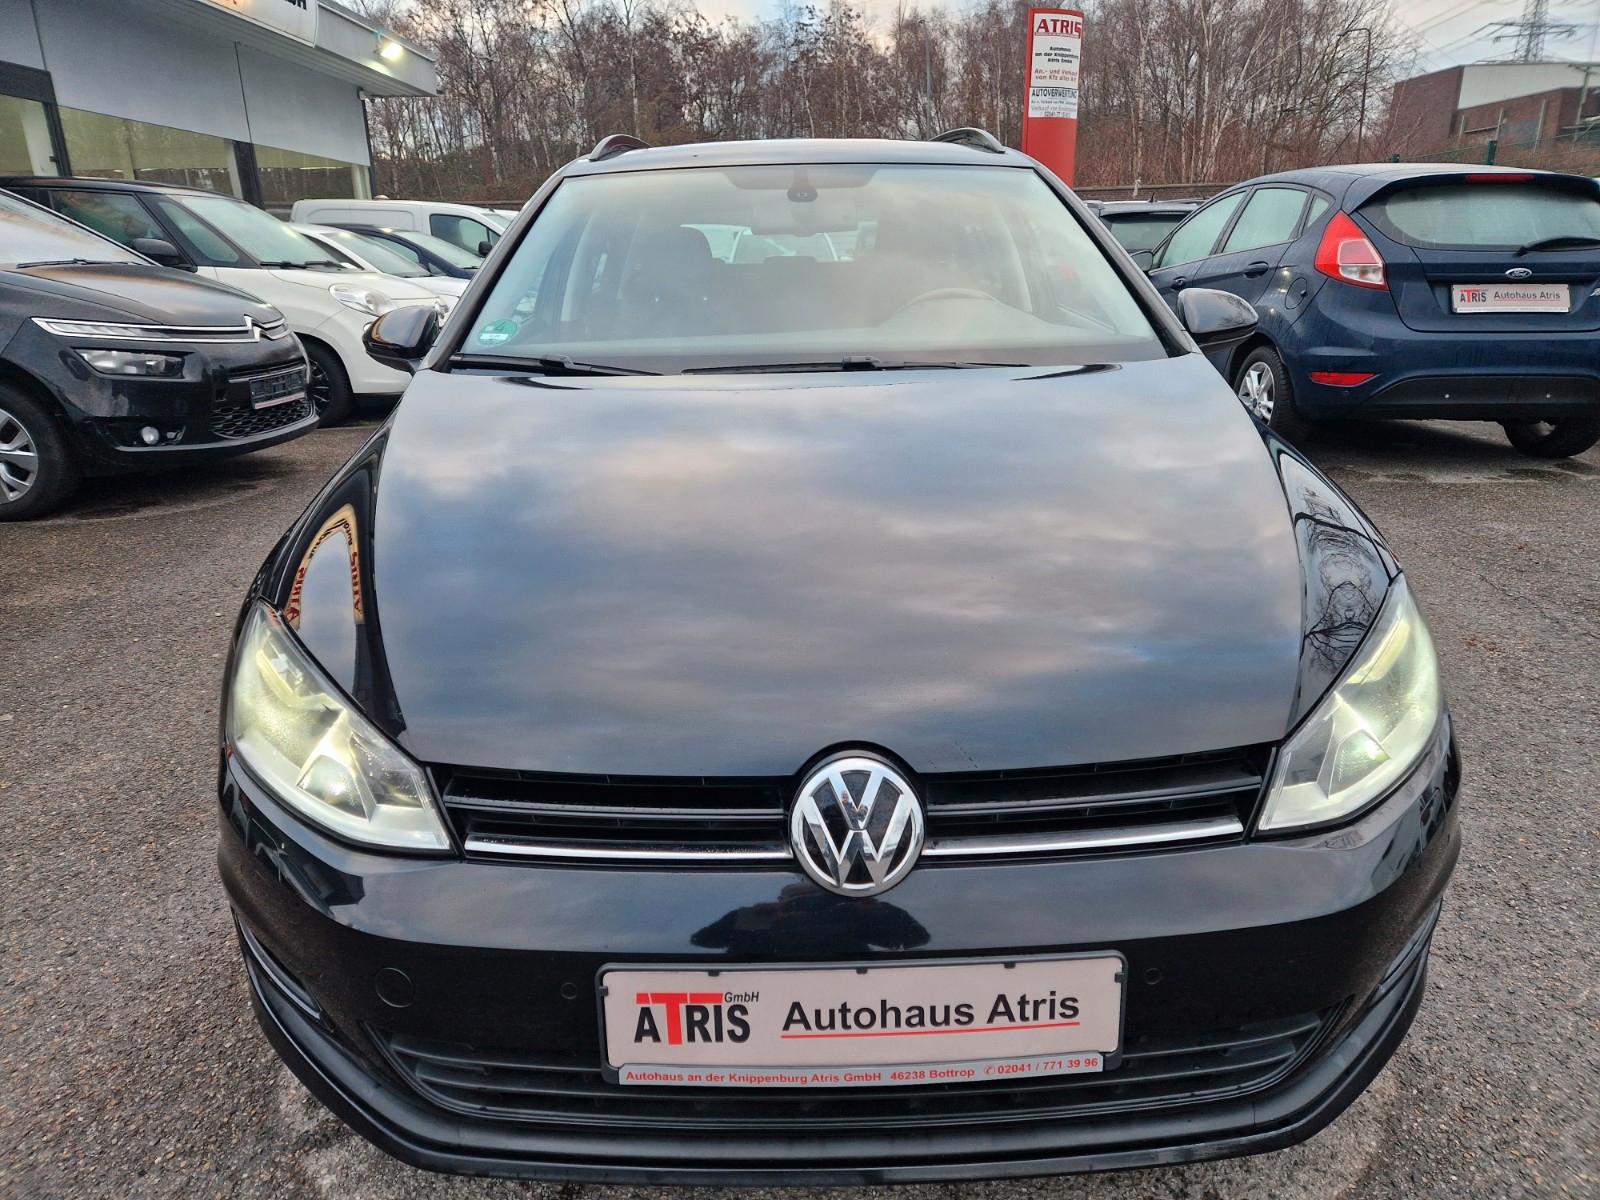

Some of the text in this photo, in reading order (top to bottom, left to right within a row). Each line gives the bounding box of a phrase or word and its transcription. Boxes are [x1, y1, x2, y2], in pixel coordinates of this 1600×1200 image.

[1036, 18, 1082, 35] ATRIS
[1510, 269, 1528, 278] Ford
[1460, 288, 1487, 303] ATRIS
[1494, 291, 1561, 300] Autohaus Atris
[797, 762, 918, 890] VW
[724, 991, 760, 1004] GmbH
[634, 993, 751, 1046] ATRIS
[782, 989, 1081, 1033] Autohaus Atris
[625, 1071, 684, 1082] Autohaus
[687, 1074, 702, 1082] an
[705, 1072, 725, 1083] der
[729, 1073, 808, 1085] Knippenburg
[811, 1073, 840, 1083] Atris
[843, 1072, 882, 1083] GmbH
[890, 1070, 926, 1081] 46238
[929, 1068, 976, 1079] Bottrop
[997, 1062, 1032, 1075] 02041
[1043, 1060, 1064, 1071] 771
[1067, 1058, 1081, 1069] 39
[1083, 1057, 1099, 1068] 96
